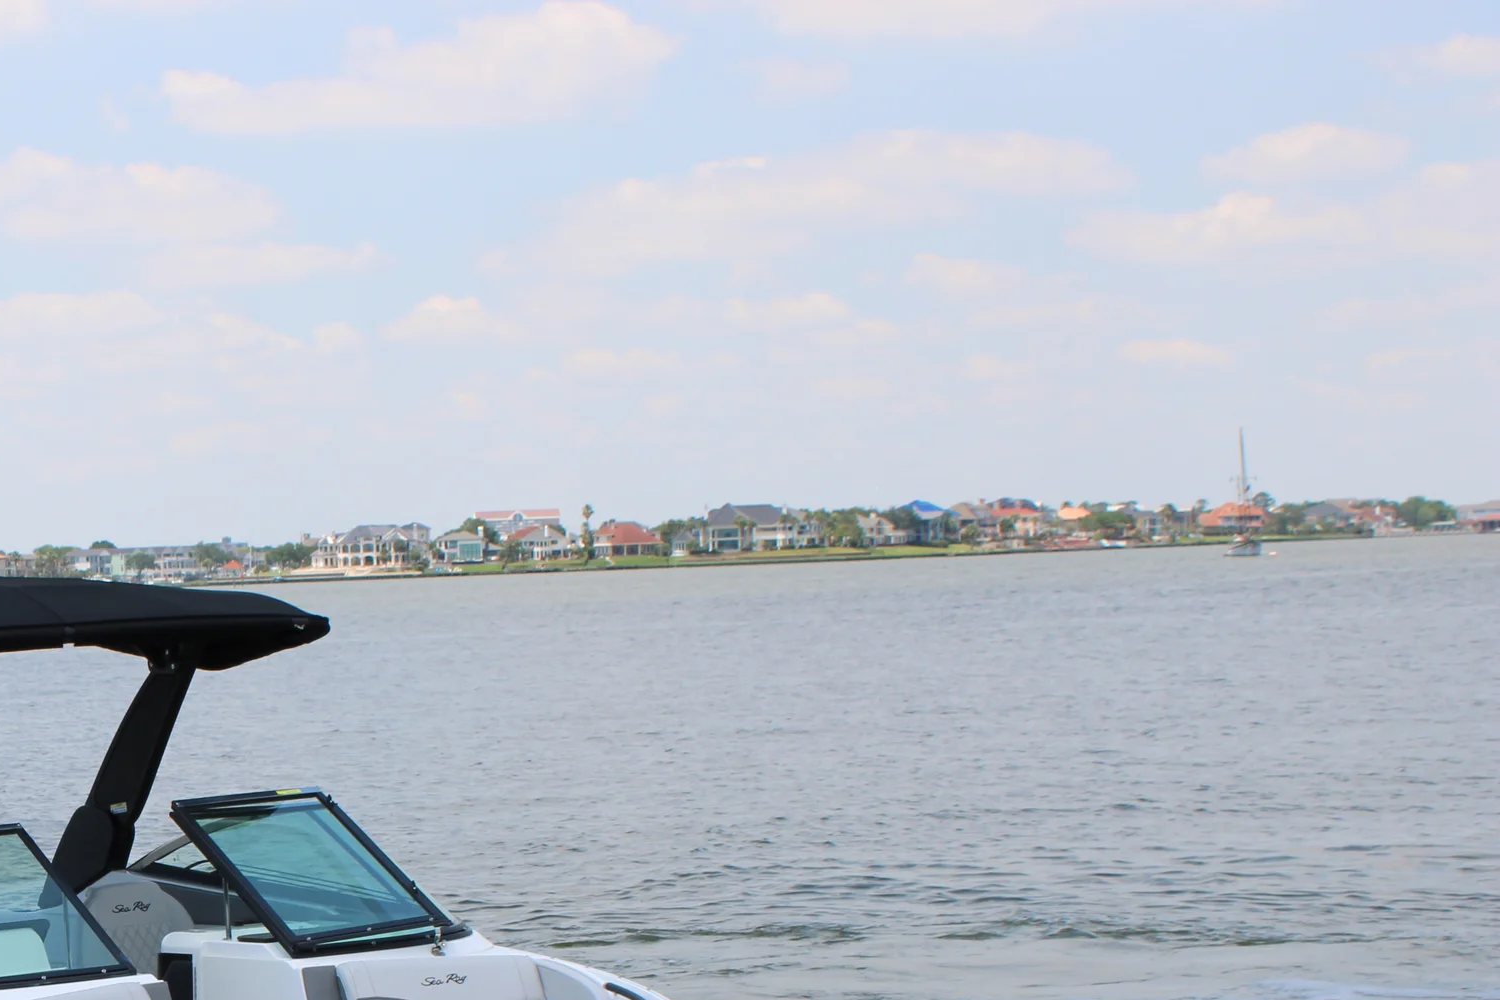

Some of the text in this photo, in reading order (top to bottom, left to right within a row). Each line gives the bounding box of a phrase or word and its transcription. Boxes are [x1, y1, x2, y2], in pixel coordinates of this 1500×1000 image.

[111, 900, 151, 914] Sea Ray
[421, 973, 467, 987] Sea Ray
